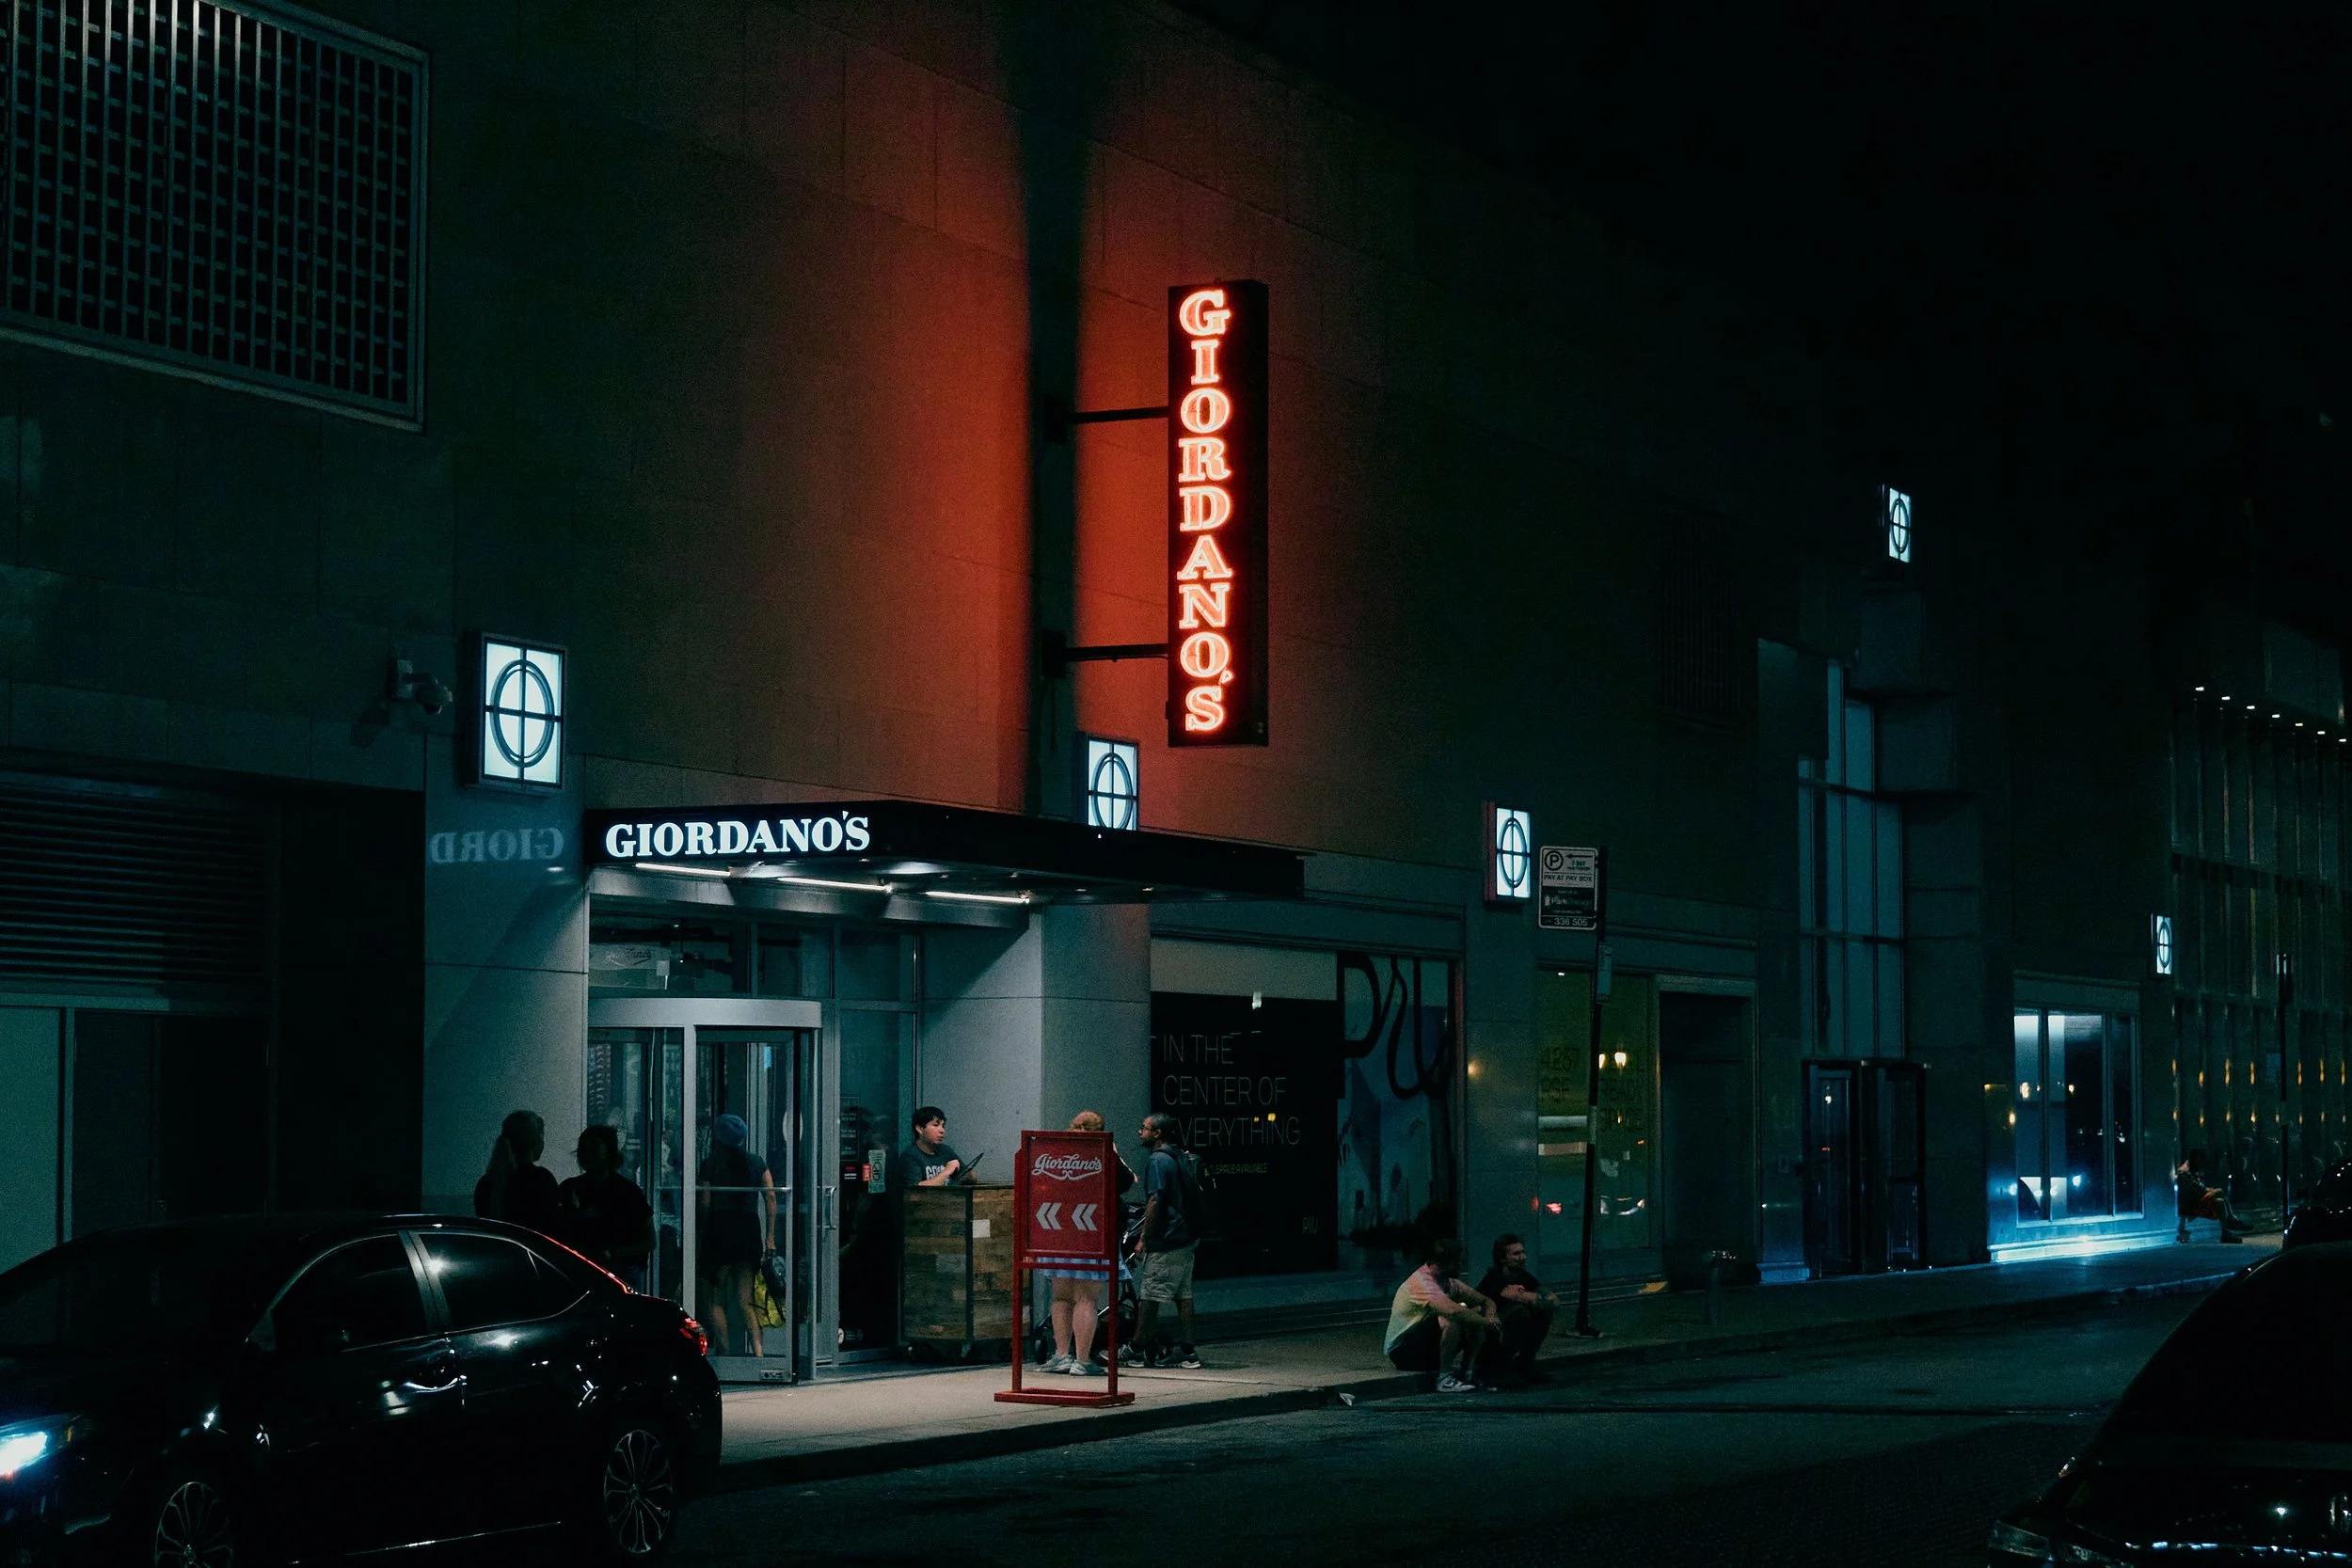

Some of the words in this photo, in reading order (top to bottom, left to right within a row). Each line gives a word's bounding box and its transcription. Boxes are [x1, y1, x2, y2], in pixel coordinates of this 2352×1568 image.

[1178, 288, 1235, 733] GIORDANO'S
[605, 810, 871, 858] GIORDANO'S
[1163, 1034, 1184, 1064] IN
[1190, 1034, 1235, 1065] THE
[1162, 1074, 1253, 1106] CENTER
[1257, 1075, 1287, 1107] OF
[1031, 1153, 1104, 1180] Giordano's
